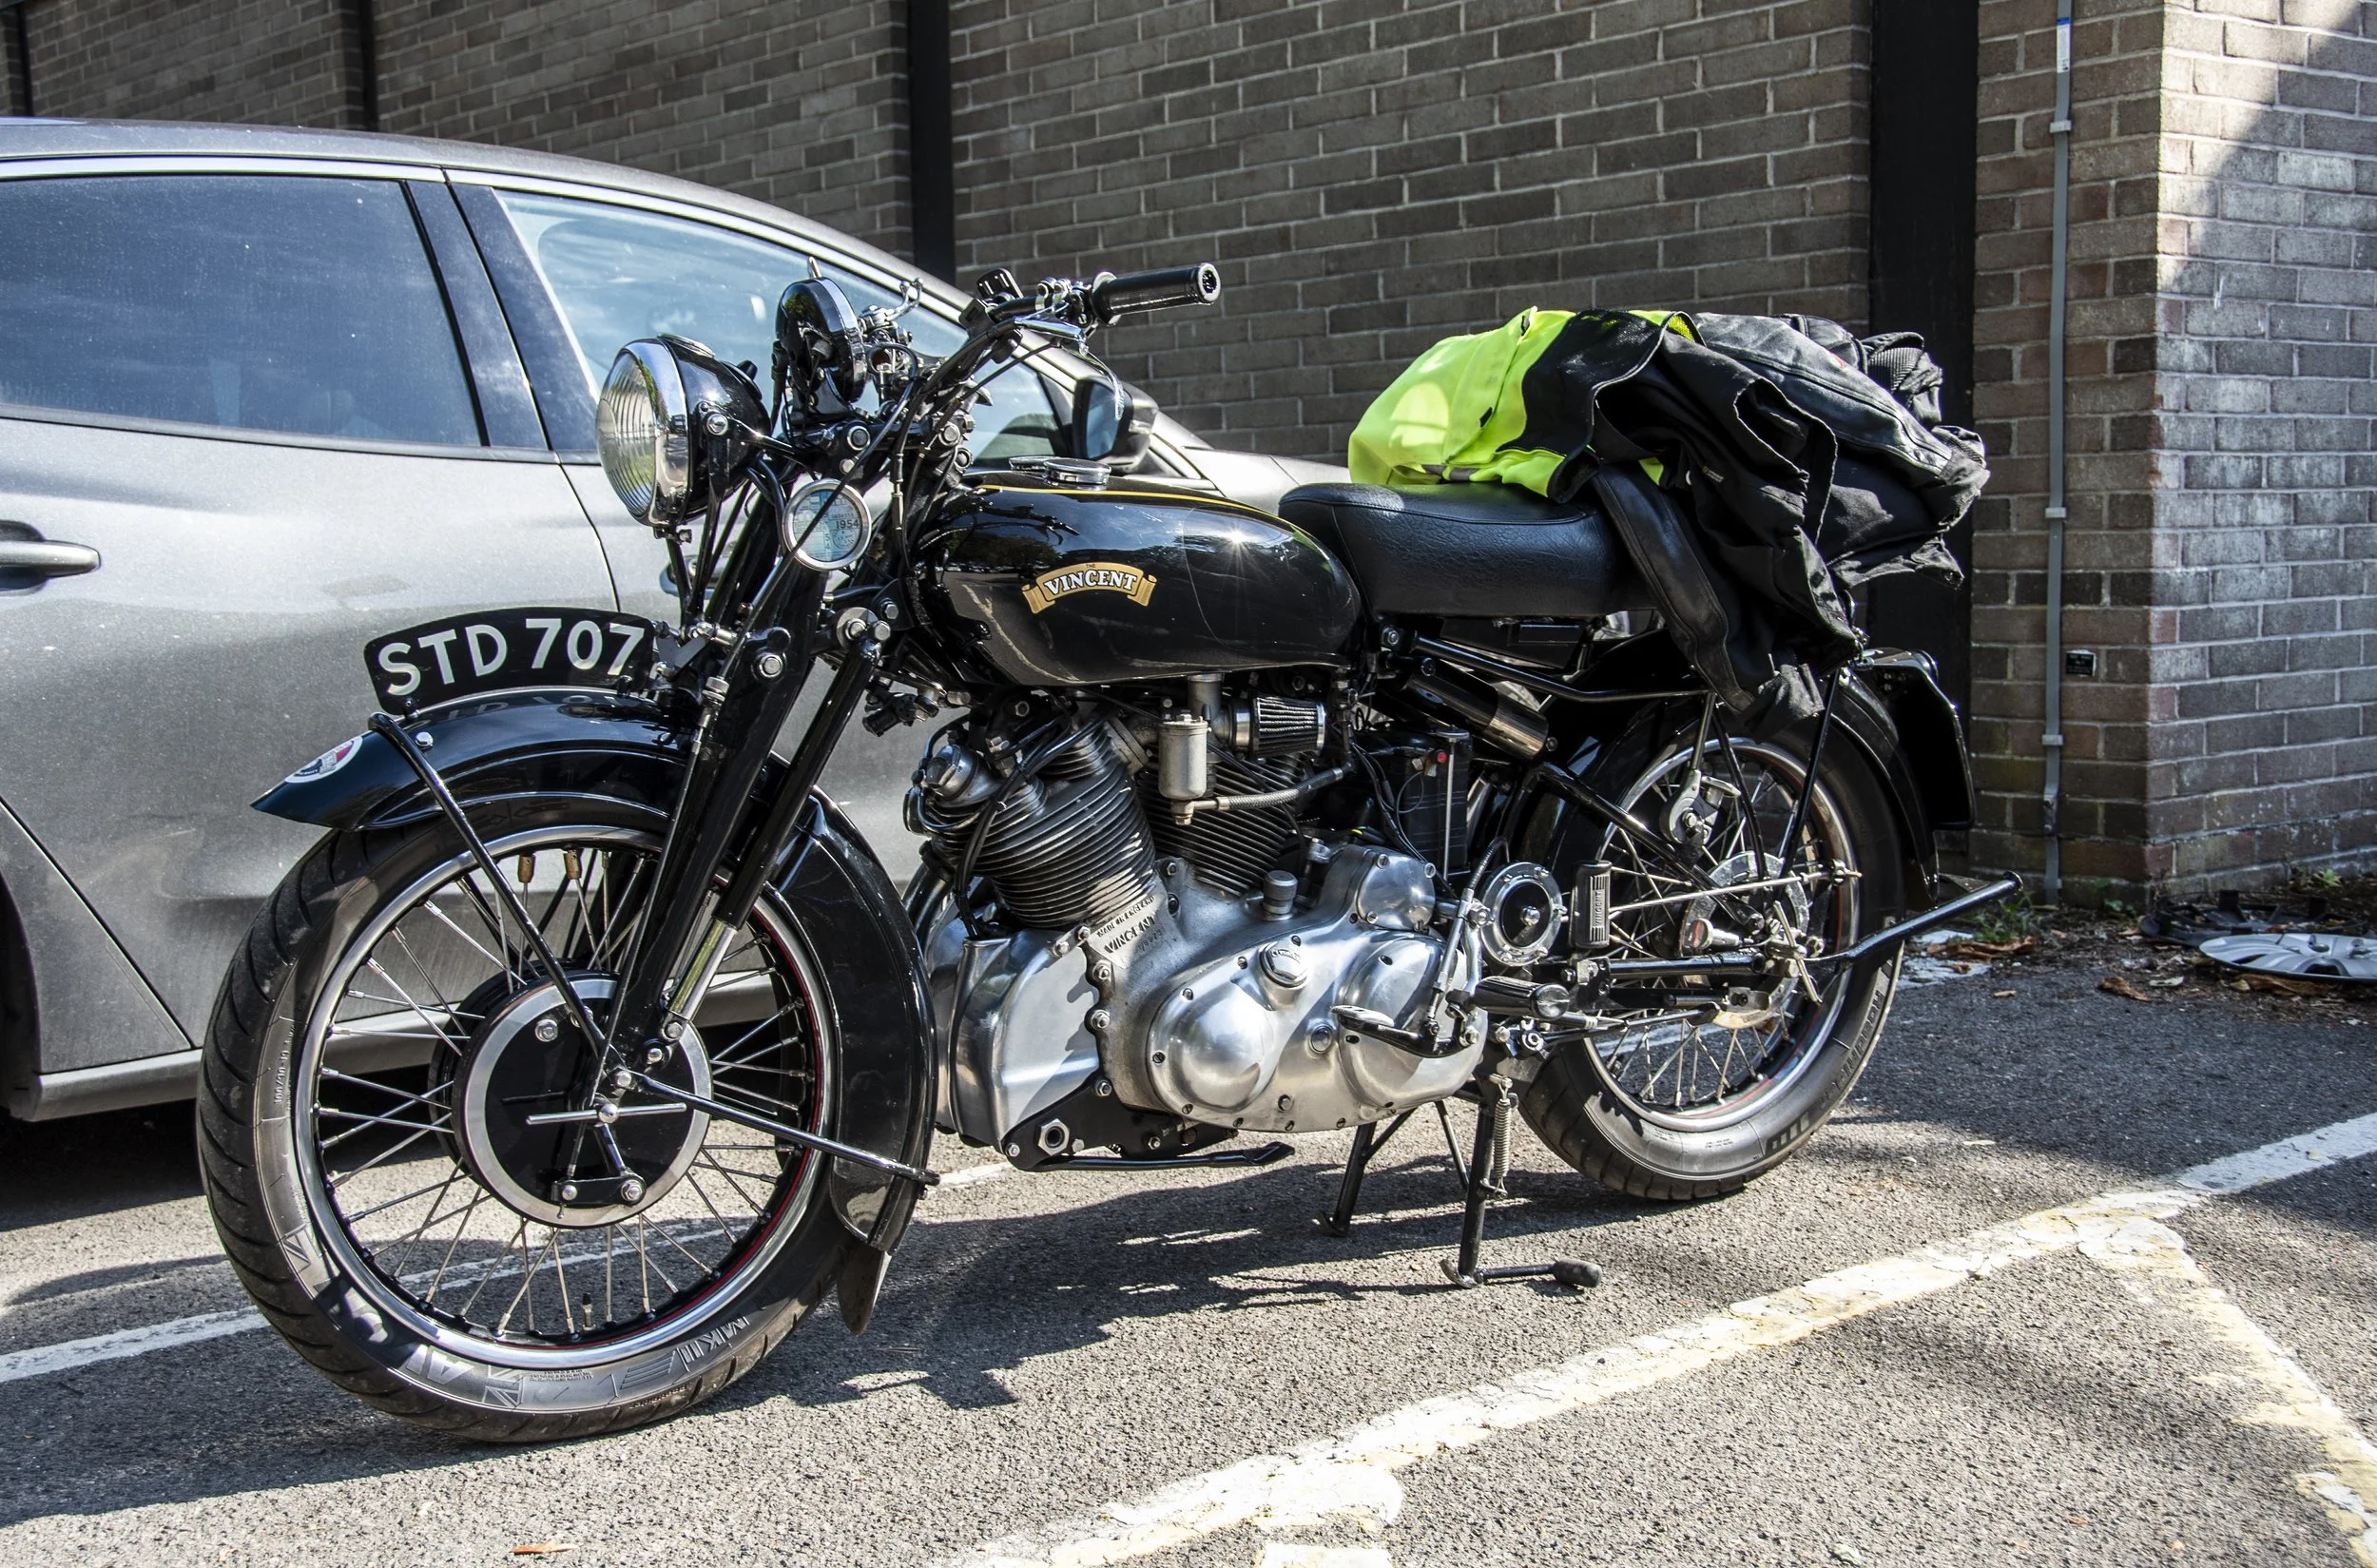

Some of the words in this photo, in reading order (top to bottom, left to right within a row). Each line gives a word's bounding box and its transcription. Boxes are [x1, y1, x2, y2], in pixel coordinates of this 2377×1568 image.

[1044, 570, 1137, 595] VINCENT
[378, 624, 508, 696] STD
[525, 618, 645, 676] 707
[1104, 914, 1156, 954] VINCENT
